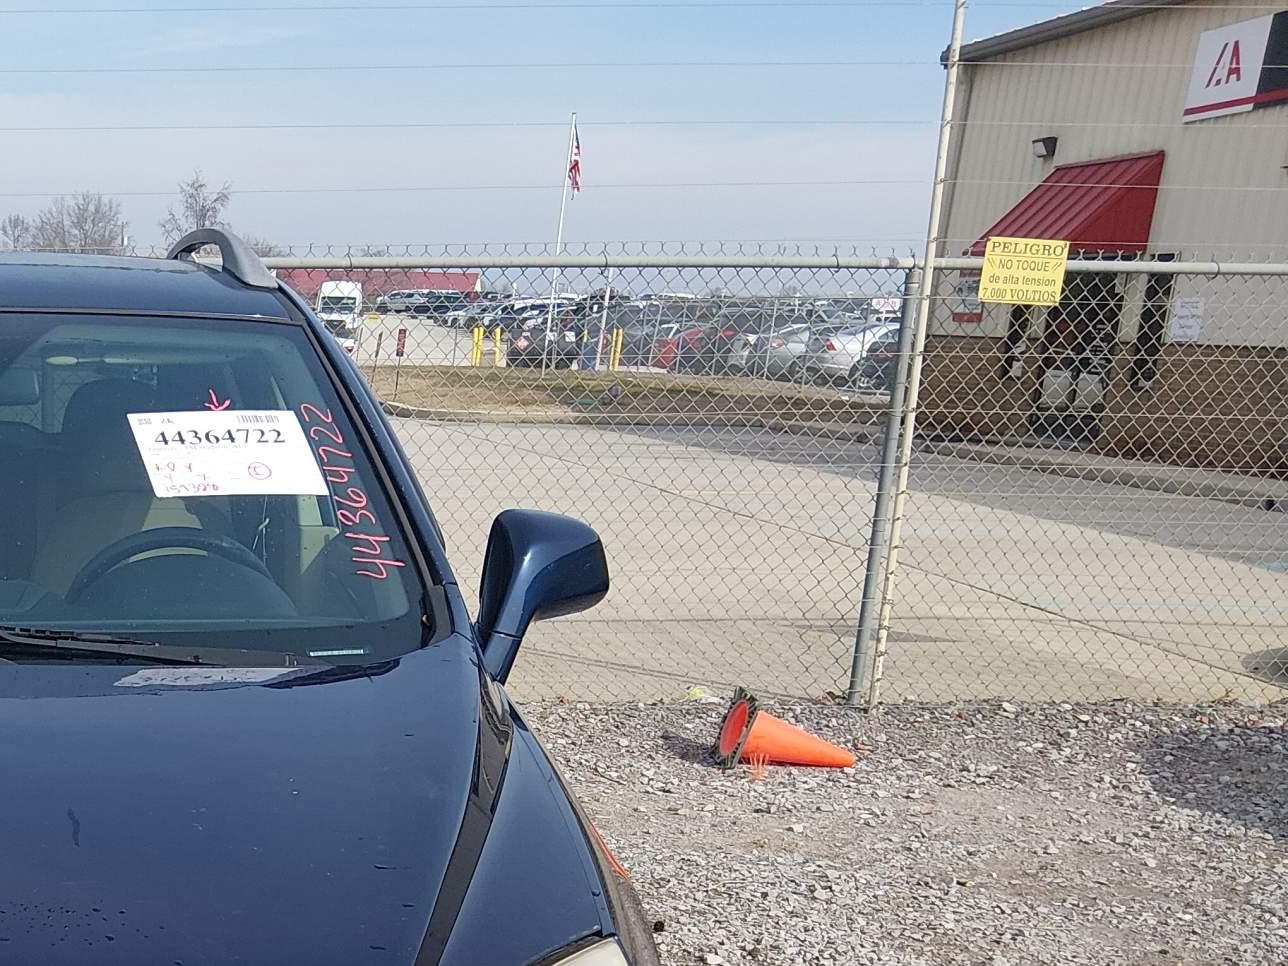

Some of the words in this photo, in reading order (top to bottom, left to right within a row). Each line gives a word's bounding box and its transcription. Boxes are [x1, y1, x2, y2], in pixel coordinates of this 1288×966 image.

[991, 241, 1064, 257] PELIGRO
[998, 259, 1013, 270] NO
[1016, 260, 1050, 272] TOQUE
[989, 273, 1000, 283] de
[1002, 275, 1019, 285] alta
[982, 287, 1007, 299] 7.000
[1010, 289, 1057, 301] VOLTIOS
[154, 428, 286, 446] 44364722
[300, 403, 405, 579] 44364722
